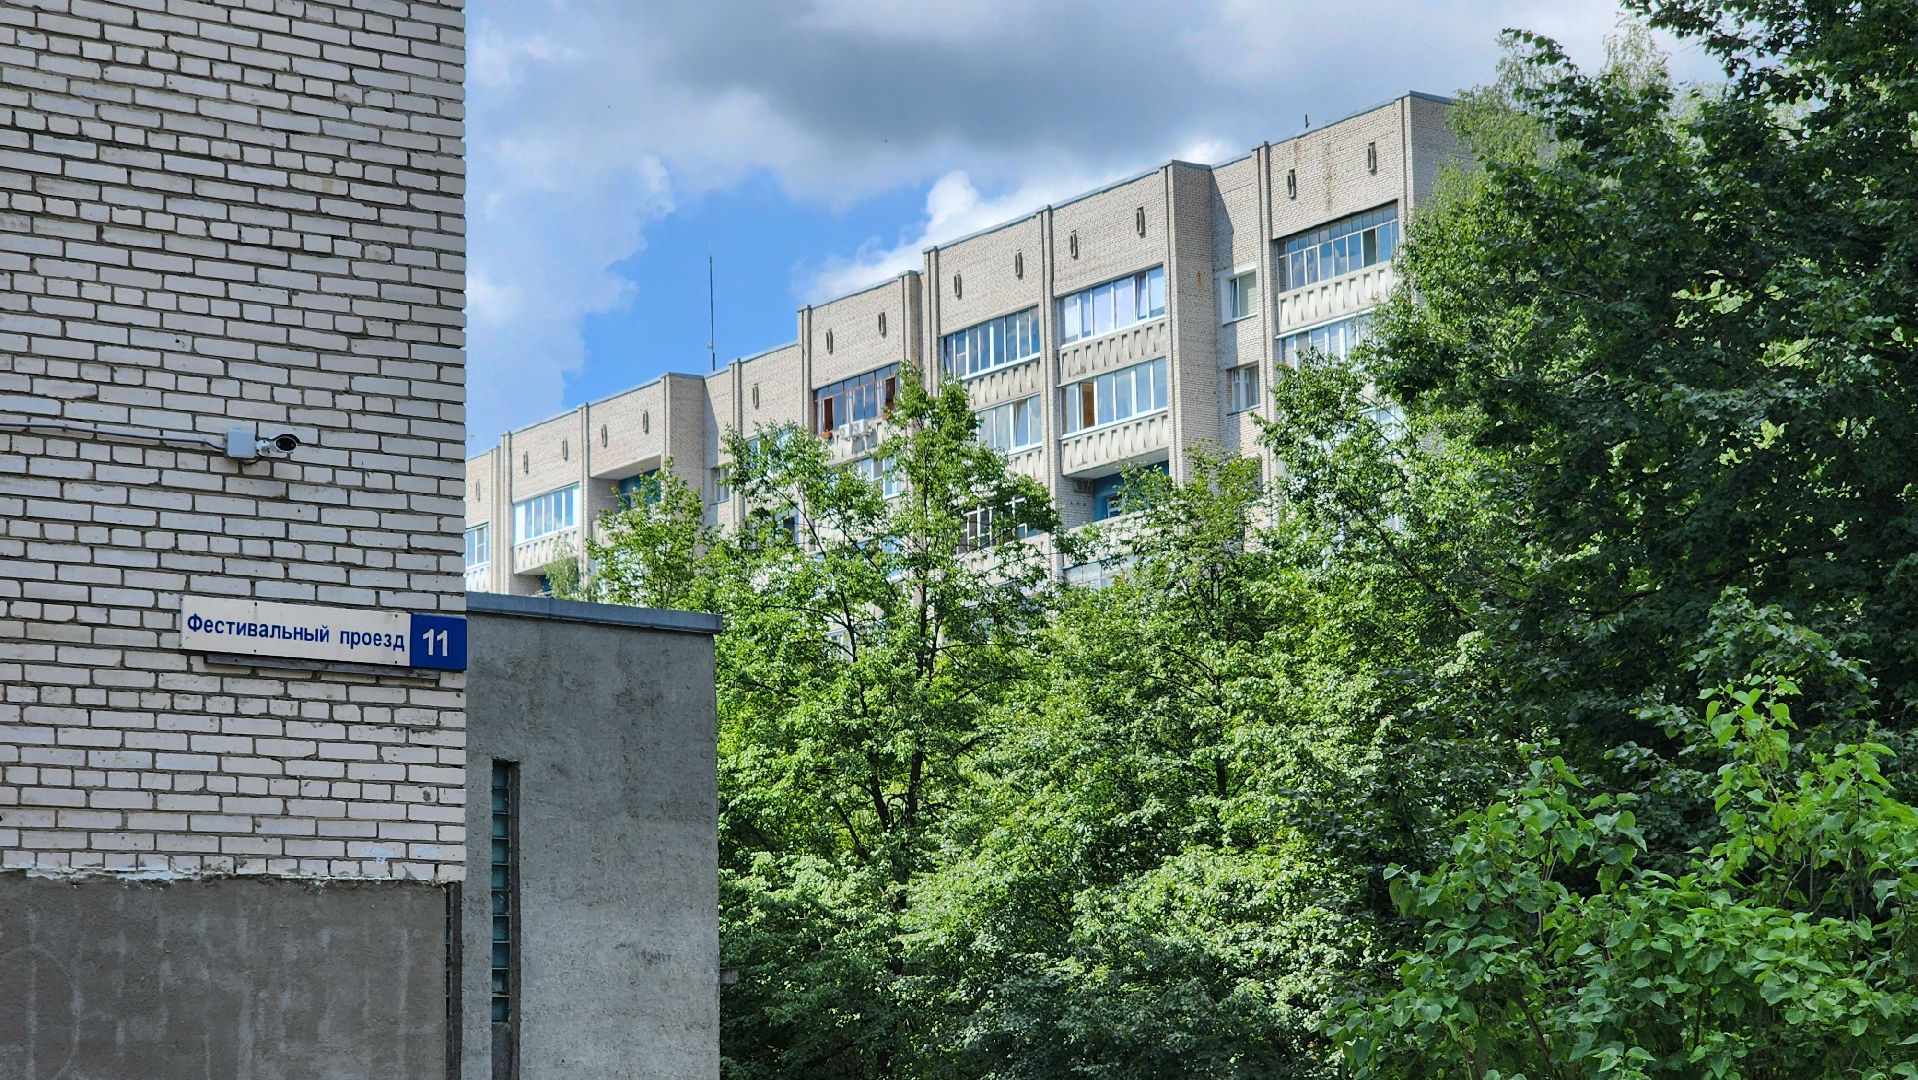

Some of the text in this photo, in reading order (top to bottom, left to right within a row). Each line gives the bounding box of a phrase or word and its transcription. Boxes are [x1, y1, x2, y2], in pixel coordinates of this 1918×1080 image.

[187, 613, 448, 657] Фестивальный проезд 11
